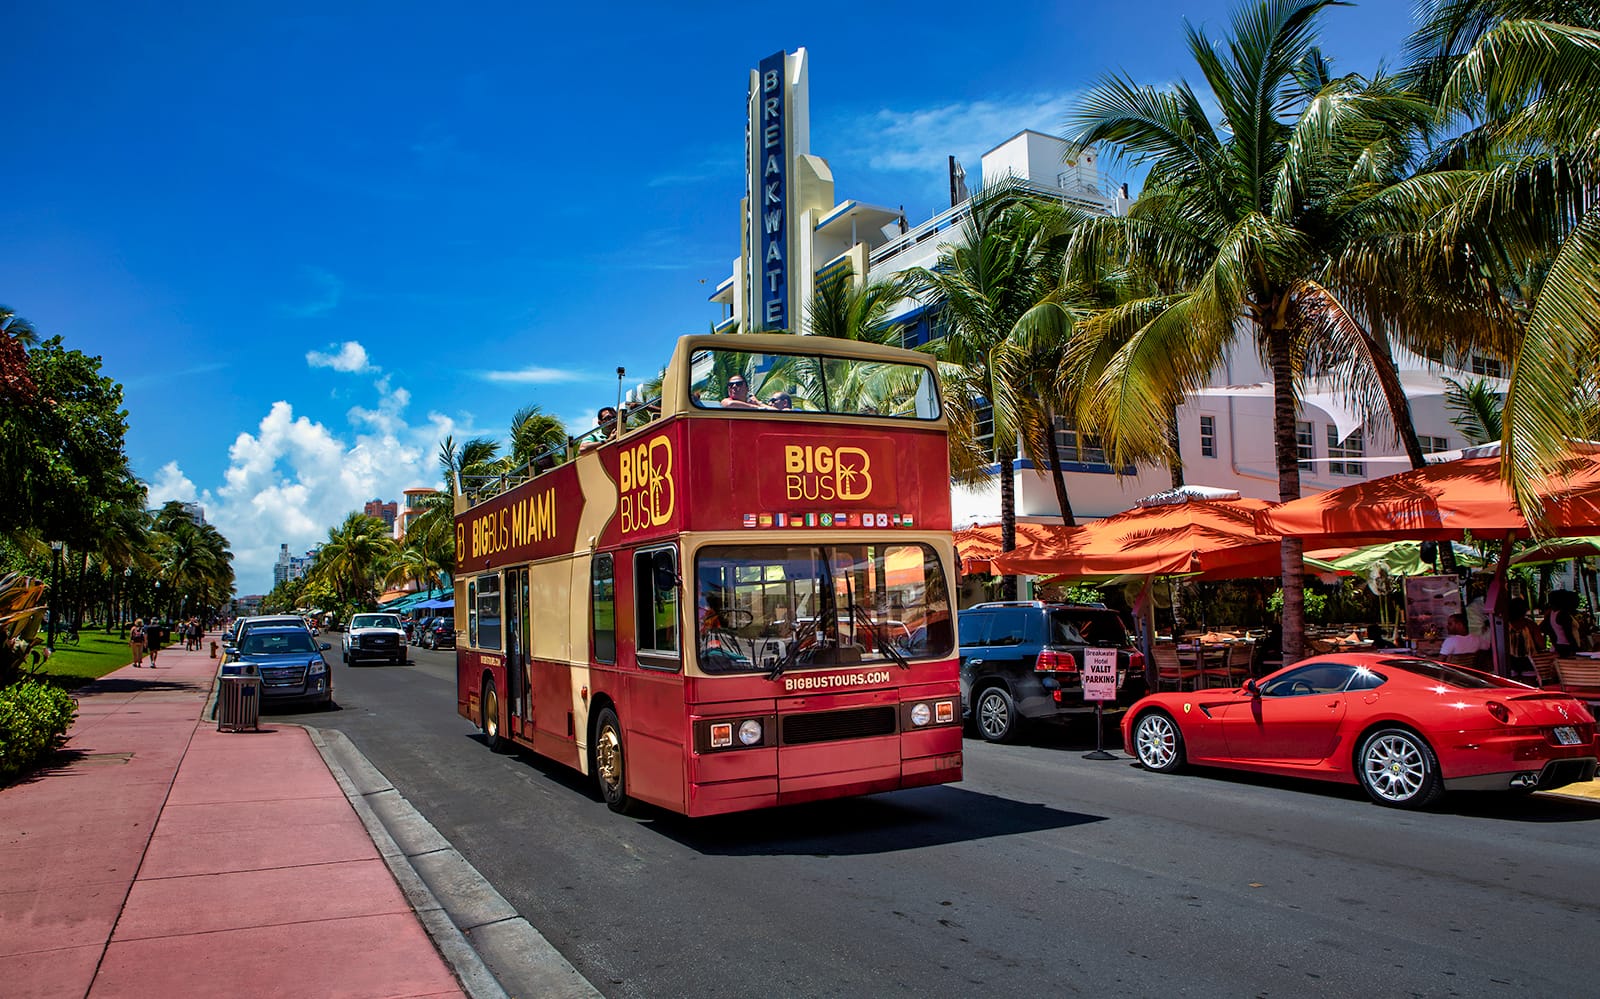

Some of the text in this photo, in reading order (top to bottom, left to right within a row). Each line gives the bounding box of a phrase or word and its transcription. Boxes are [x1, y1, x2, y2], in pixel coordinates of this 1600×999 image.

[763, 69, 783, 330] BREAKWATE
[620, 443, 648, 492] BIG
[785, 445, 834, 474] BIG
[786, 475, 835, 501] BUS
[512, 487, 556, 548] MIAMI
[621, 490, 650, 532] BUS
[1086, 649, 1115, 657] Breakwater
[785, 672, 890, 690] BIGBUSTOURS.COM
[1085, 675, 1115, 684] PARKING
[1091, 665, 1111, 673] VALET
